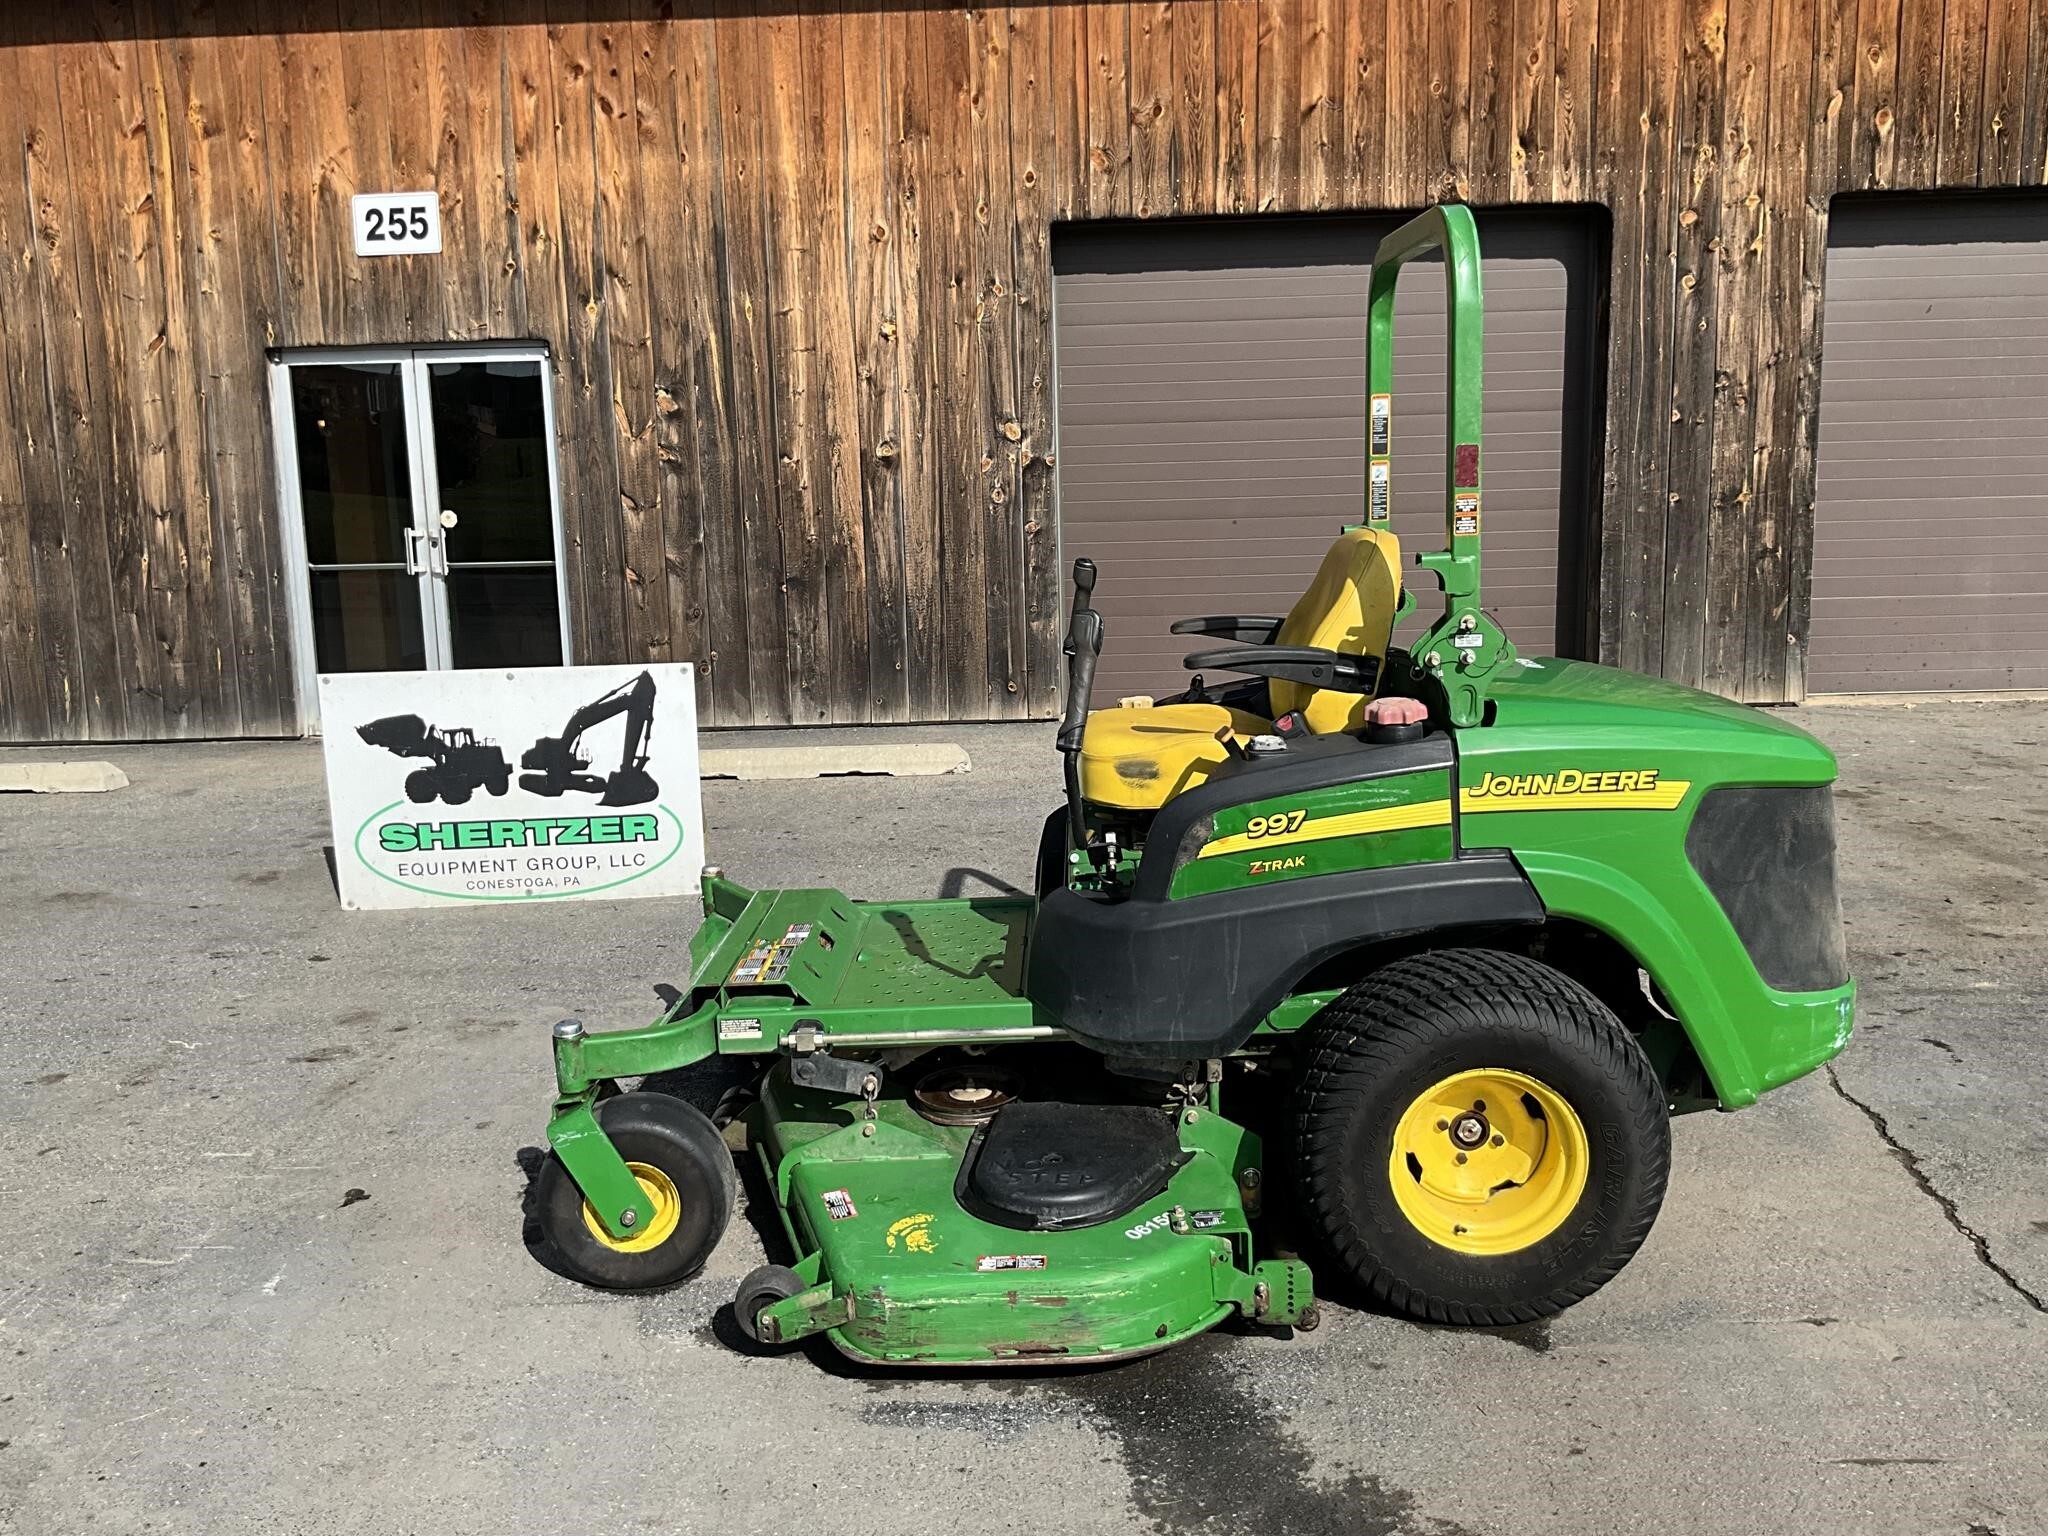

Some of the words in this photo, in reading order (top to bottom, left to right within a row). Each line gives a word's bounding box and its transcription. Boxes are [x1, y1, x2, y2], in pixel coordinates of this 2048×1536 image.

[365, 207, 429, 241] 255
[1468, 771, 1554, 797] JOHN
[1553, 768, 1660, 795] DEERE
[378, 814, 659, 852] SHERTZER
[1247, 809, 1308, 838] 997
[398, 858, 518, 877] EQUIPMENT
[526, 855, 601, 873] GROUP,
[609, 853, 647, 869] LLC
[466, 877, 559, 891] CONESTOGA,
[563, 876, 581, 887] PA
[1007, 1172, 1095, 1186] STEP
